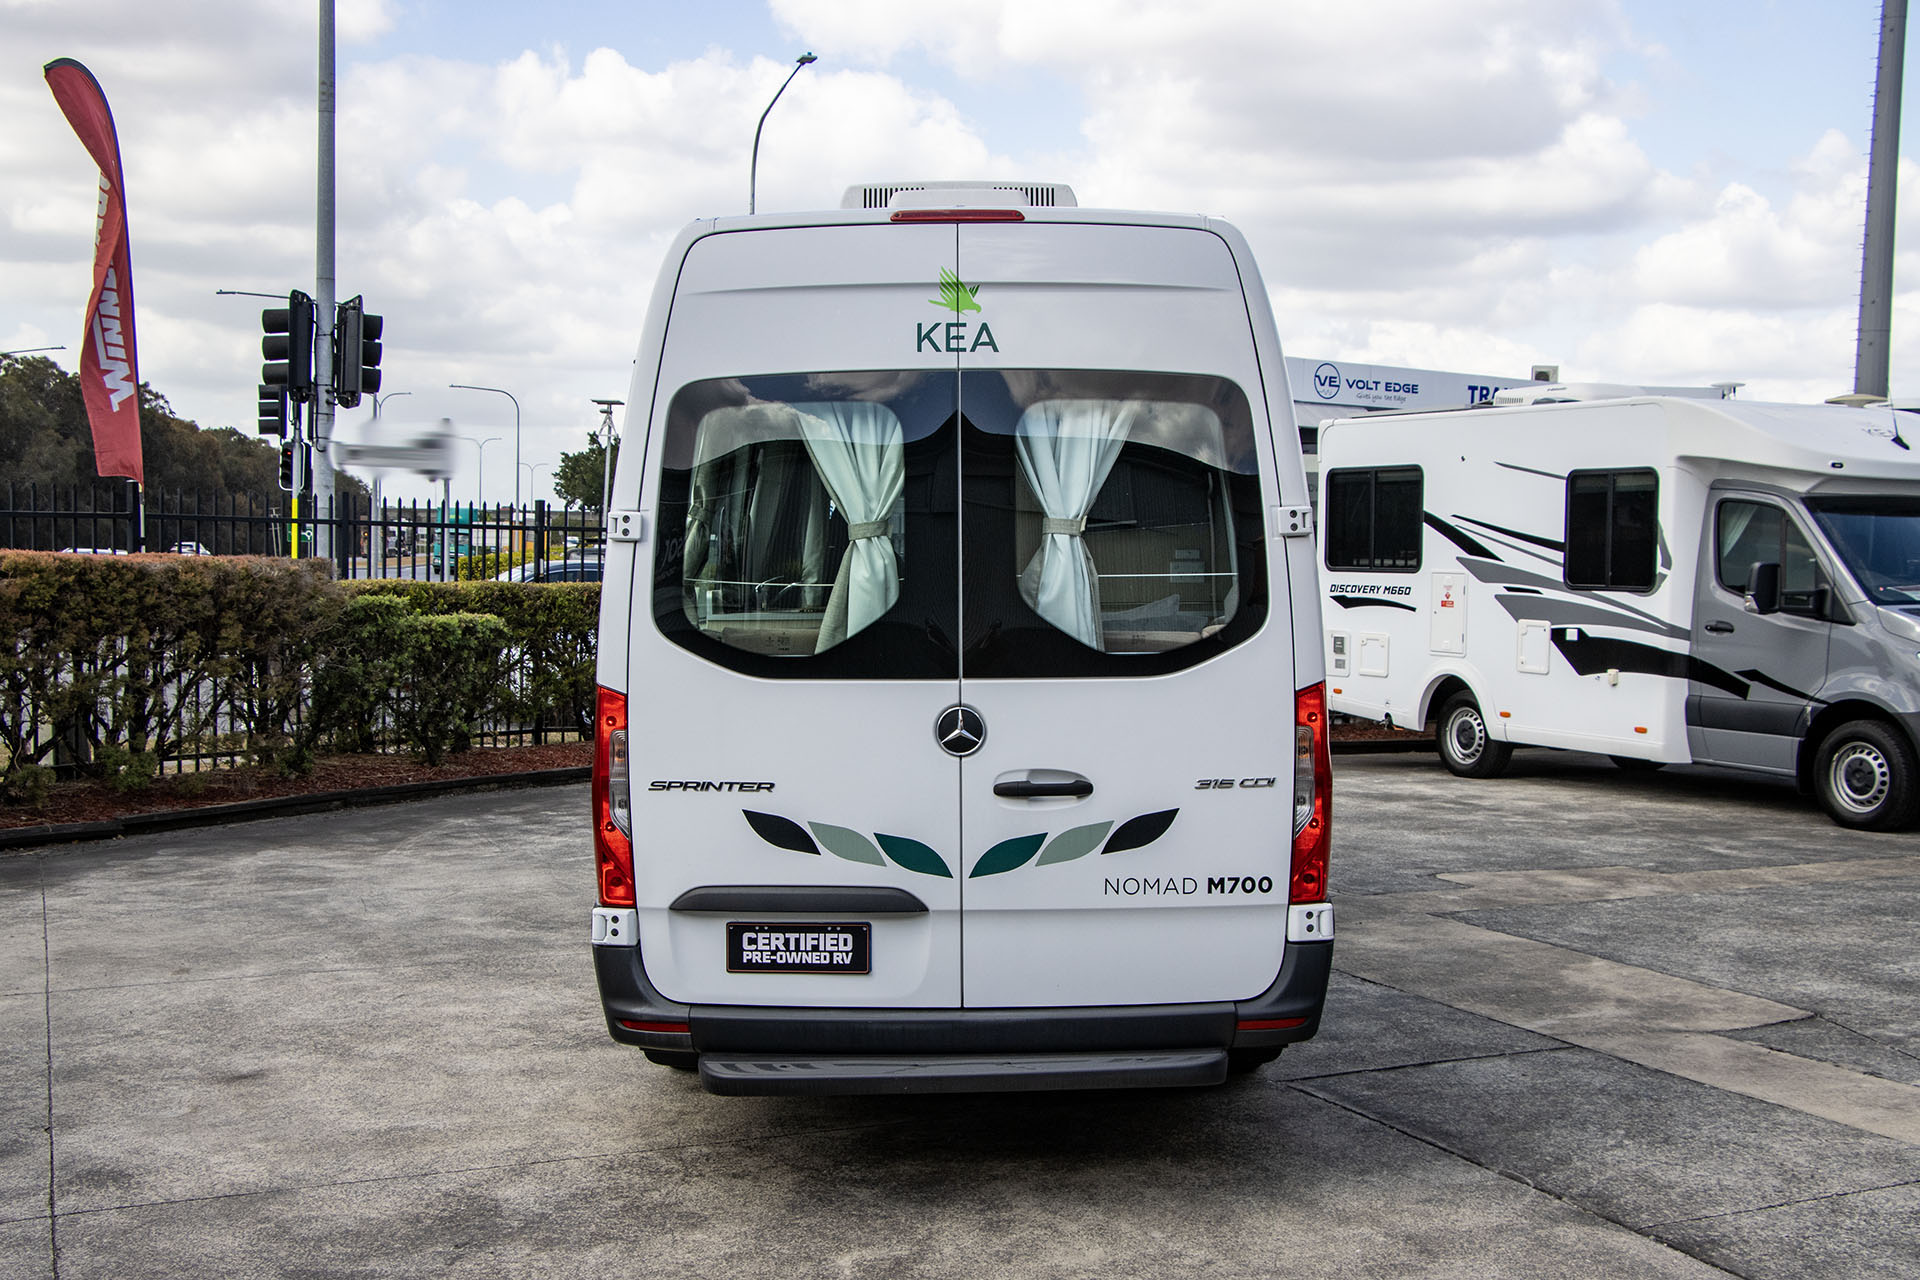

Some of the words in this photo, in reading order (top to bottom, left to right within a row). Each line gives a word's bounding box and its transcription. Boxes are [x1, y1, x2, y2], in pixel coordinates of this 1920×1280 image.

[916, 322, 1000, 352] KEA
[1346, 378, 1381, 391] VOLT
[1385, 382, 1419, 394] EDGE
[1329, 584, 1382, 594] DISCOVERY
[1382, 586, 1412, 596] M660
[648, 780, 776, 793] SPRINTER
[1239, 777, 1277, 788] CDI
[1104, 877, 1198, 895] NOMAD
[1207, 876, 1273, 894] M700
[742, 932, 853, 951] CERTIFIED
[742, 951, 830, 964] PRE-OWNED
[832, 952, 853, 964] RV
